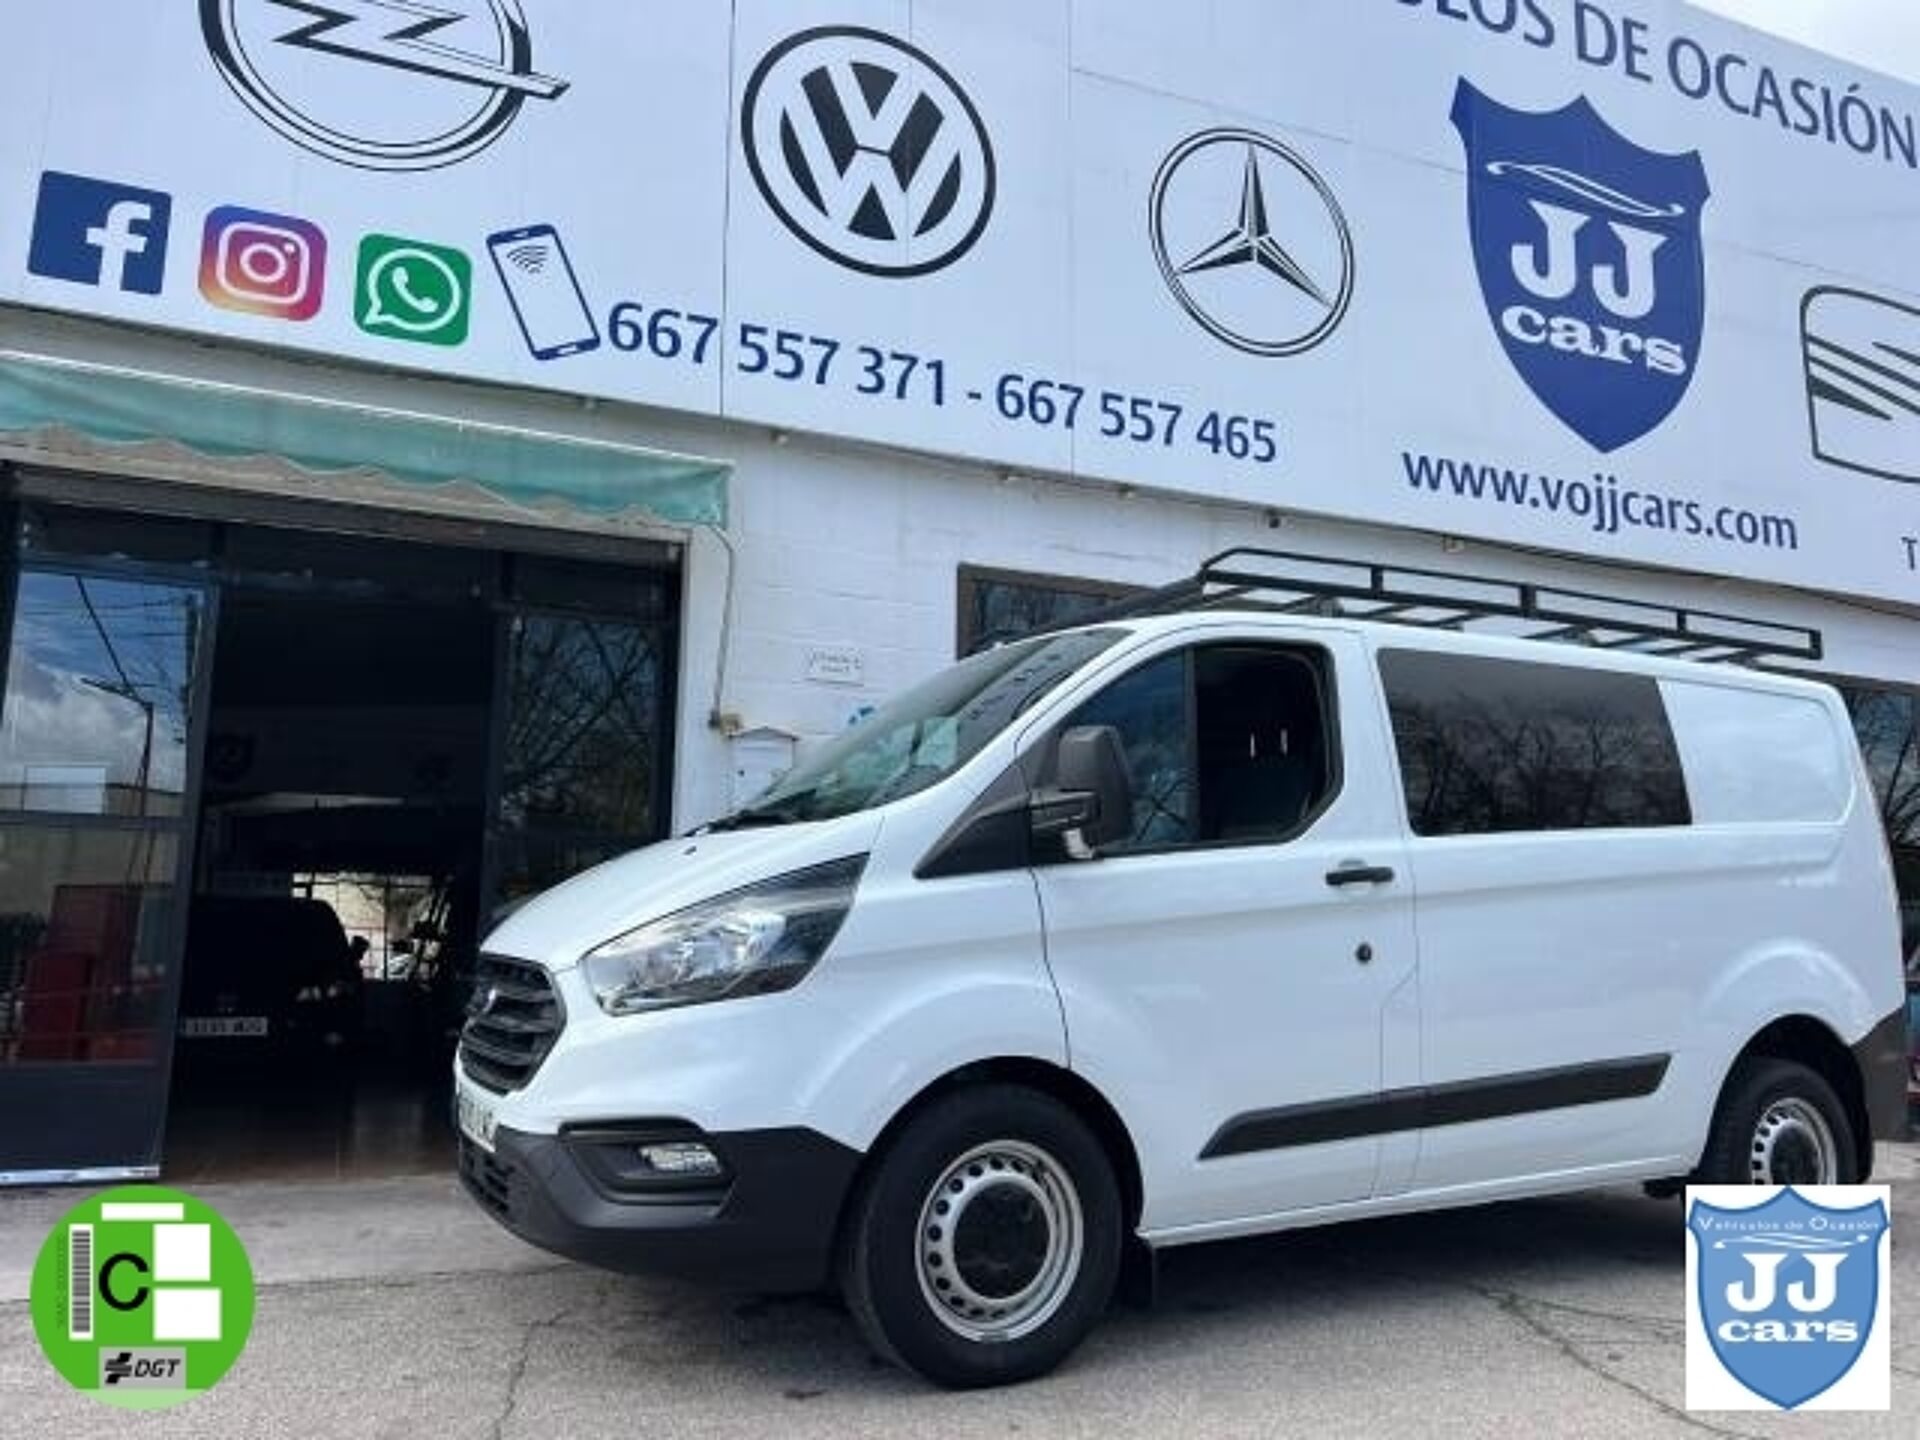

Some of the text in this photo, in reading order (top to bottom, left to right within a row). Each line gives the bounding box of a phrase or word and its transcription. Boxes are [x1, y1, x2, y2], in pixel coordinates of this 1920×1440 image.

[1575, 1, 1653, 83] DE
[1667, 36, 1918, 169] OCASIÓN
[1511, 199, 1669, 319] JJ
[608, 301, 718, 364] 667
[738, 323, 840, 385] 557
[856, 346, 944, 406] 371
[996, 373, 1084, 430] 667
[1101, 393, 1183, 446] 557
[1197, 411, 1276, 462] 465
[1502, 305, 1687, 376] cars
[1402, 452, 1798, 549] www.vojjcars.com
